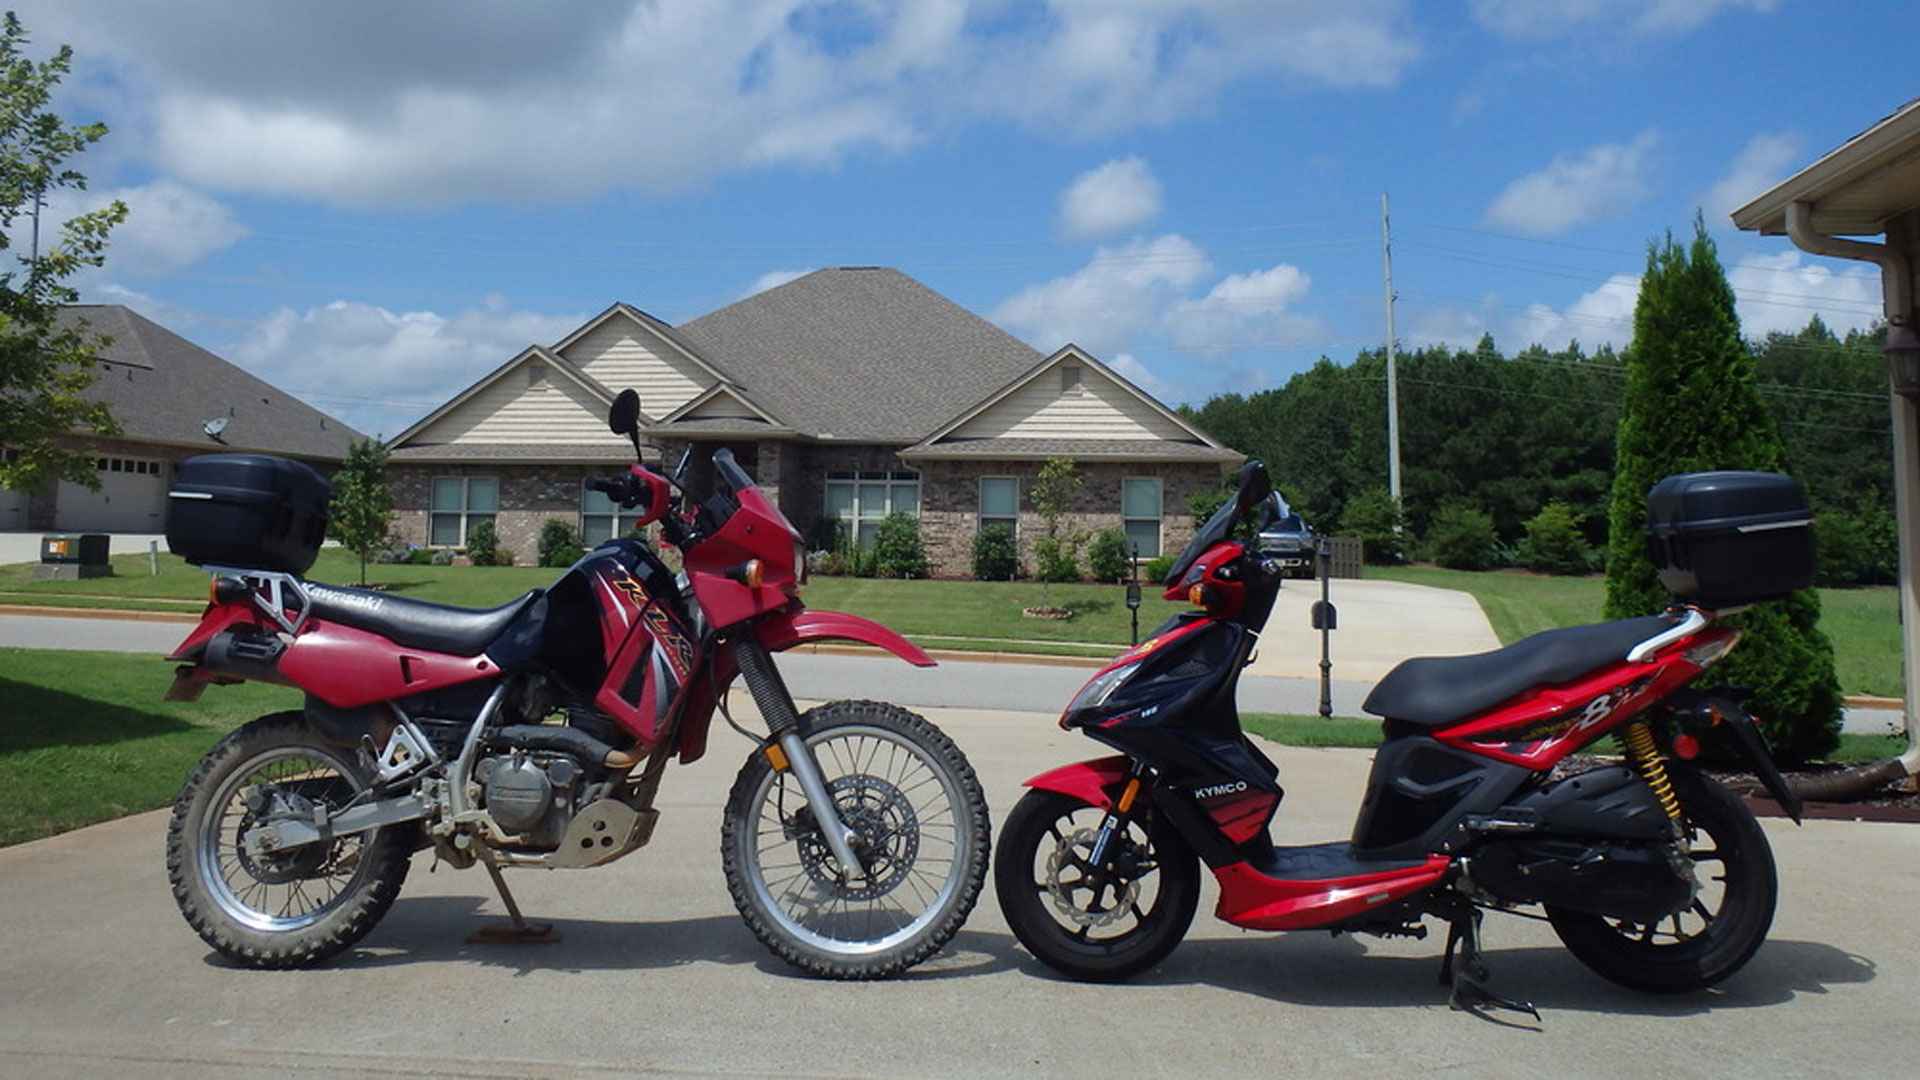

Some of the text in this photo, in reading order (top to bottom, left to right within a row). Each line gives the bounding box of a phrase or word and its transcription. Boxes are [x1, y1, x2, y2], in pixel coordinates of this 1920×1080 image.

[301, 582, 384, 611] Kawasaki
[612, 577, 694, 672] KLR
[1195, 780, 1248, 799] KYMCO
